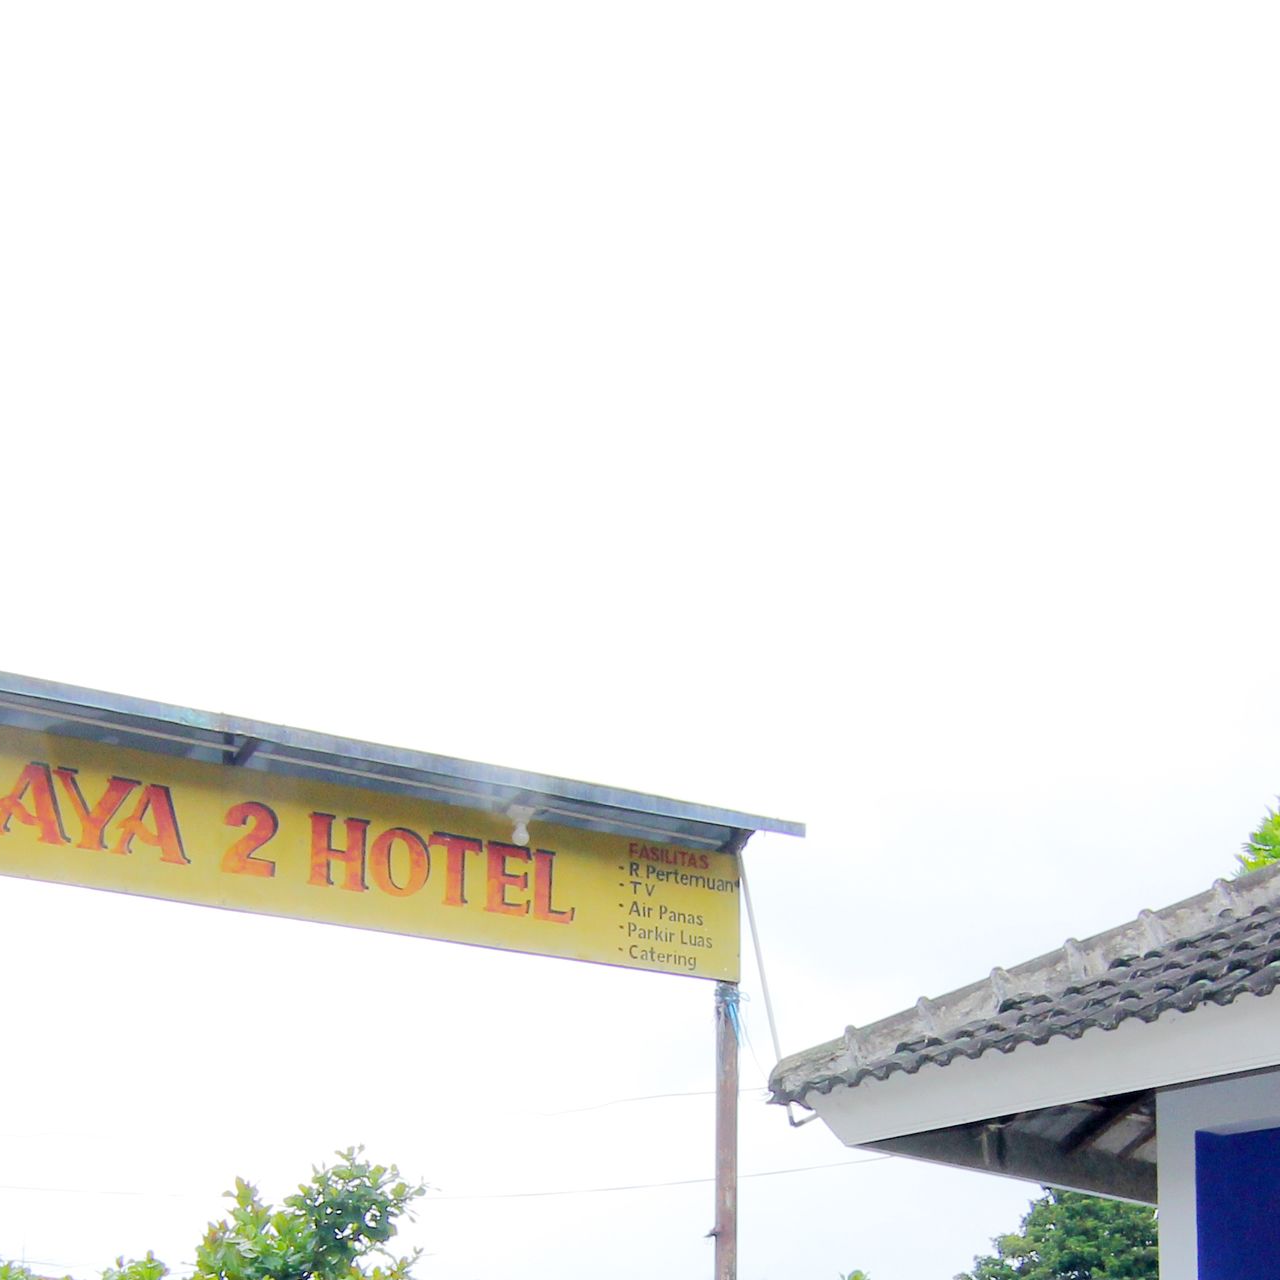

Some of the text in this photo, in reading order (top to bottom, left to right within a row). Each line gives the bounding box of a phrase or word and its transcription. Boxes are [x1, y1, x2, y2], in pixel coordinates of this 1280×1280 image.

[221, 801, 279, 878] 2
[308, 811, 576, 924] HOTEL
[628, 842, 710, 870] FASILITAS
[646, 864, 734, 893] Pertemuan
[628, 901, 704, 926] Air Panas
[628, 922, 713, 949] Parkir Luas
[629, 944, 697, 971] Catering
